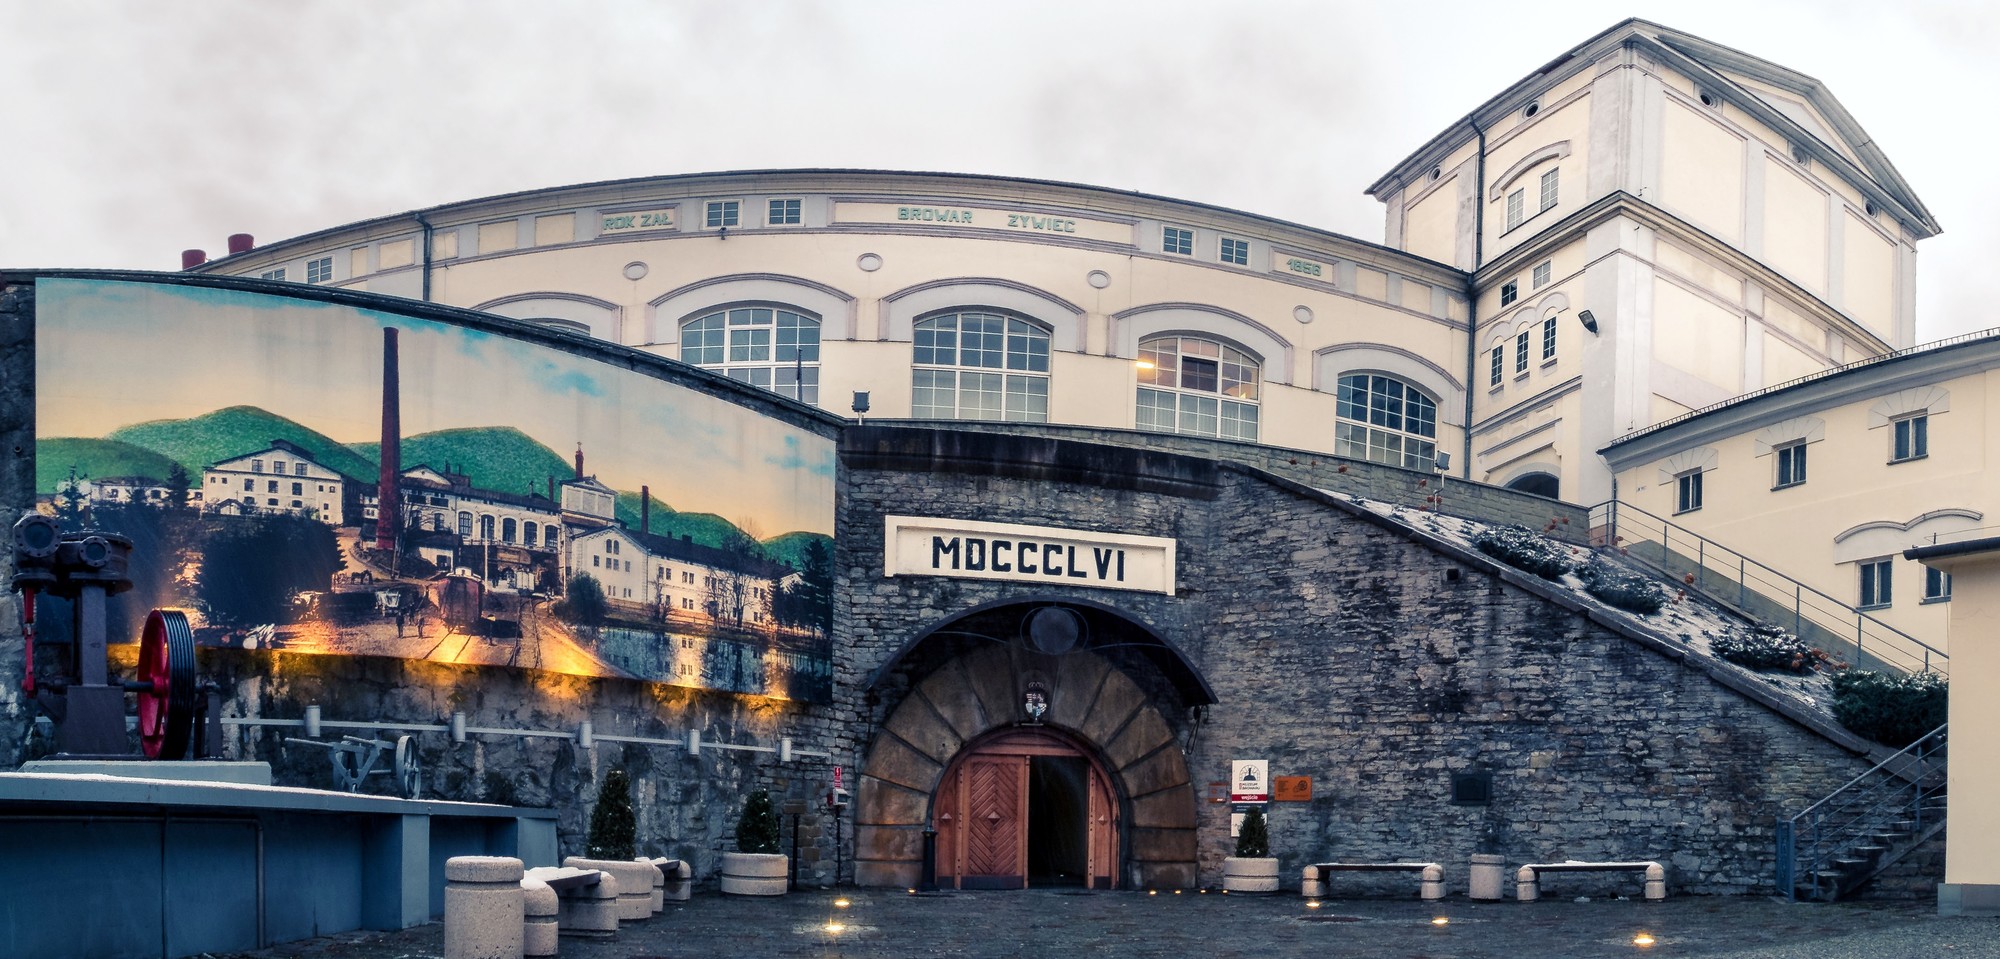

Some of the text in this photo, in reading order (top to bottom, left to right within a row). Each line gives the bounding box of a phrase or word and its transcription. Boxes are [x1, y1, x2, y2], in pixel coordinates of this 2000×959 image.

[602, 215, 636, 231] ROK
[898, 207, 1076, 233] BROWAR ZYWIEC
[1286, 258, 1322, 277] 1856
[931, 535, 1125, 582] MDCCCLVI
